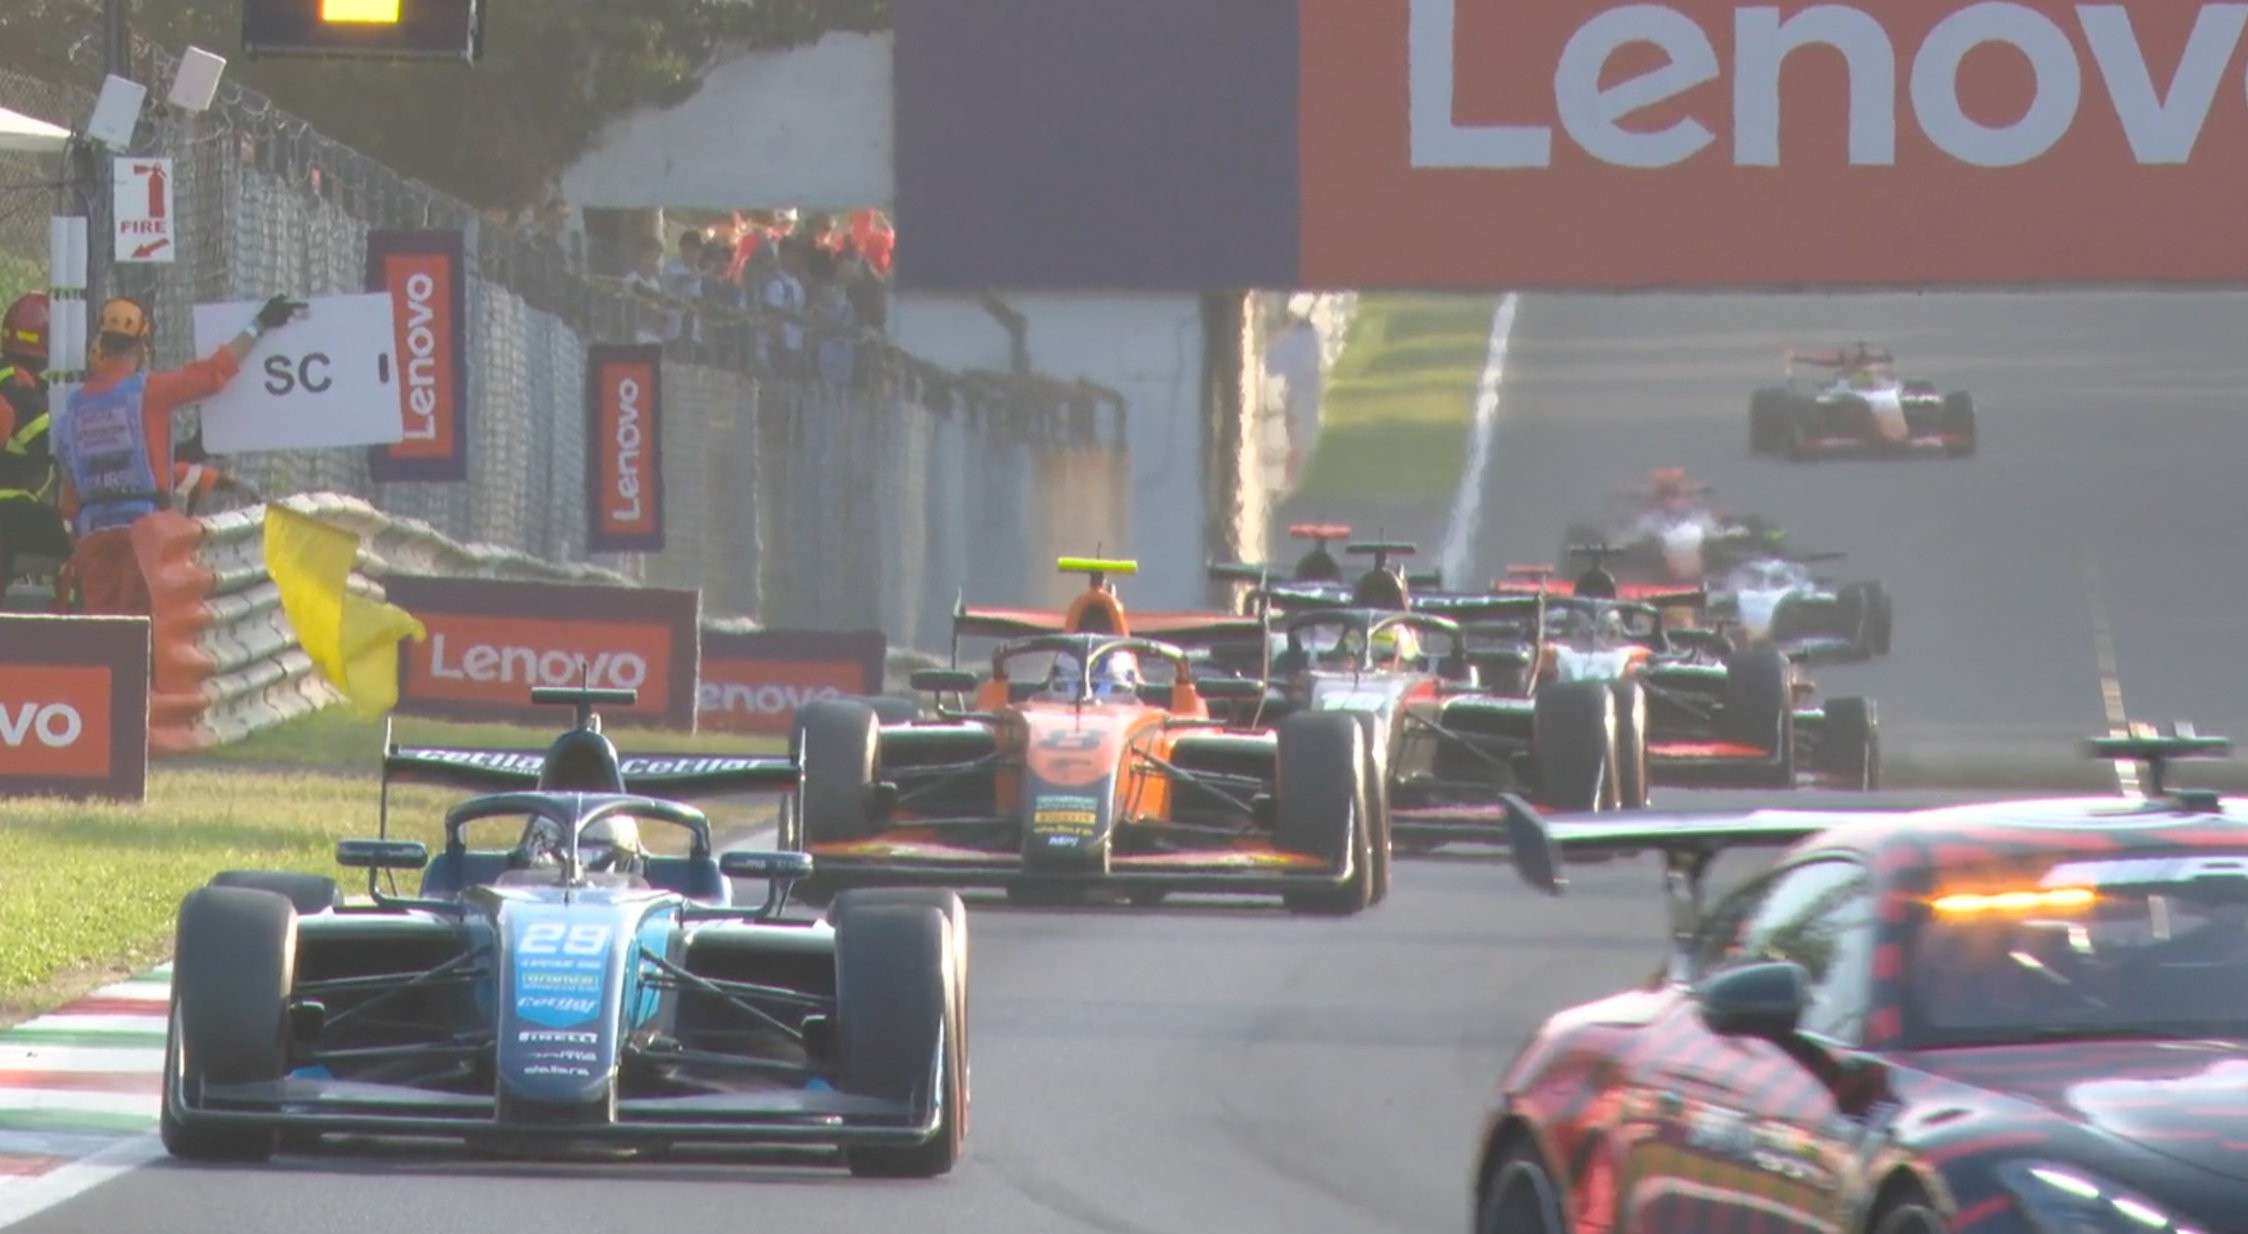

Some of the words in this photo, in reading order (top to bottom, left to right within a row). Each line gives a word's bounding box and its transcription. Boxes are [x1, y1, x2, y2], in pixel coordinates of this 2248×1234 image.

[1409, 0, 2248, 168] Lenov
[120, 220, 167, 234] FIRE
[264, 352, 332, 396] SC
[404, 273, 436, 440] Lenovo
[612, 378, 641, 520] Lenovo
[430, 633, 646, 690] Lenovo
[699, 682, 842, 715] enov
[517, 923, 611, 956] 29
